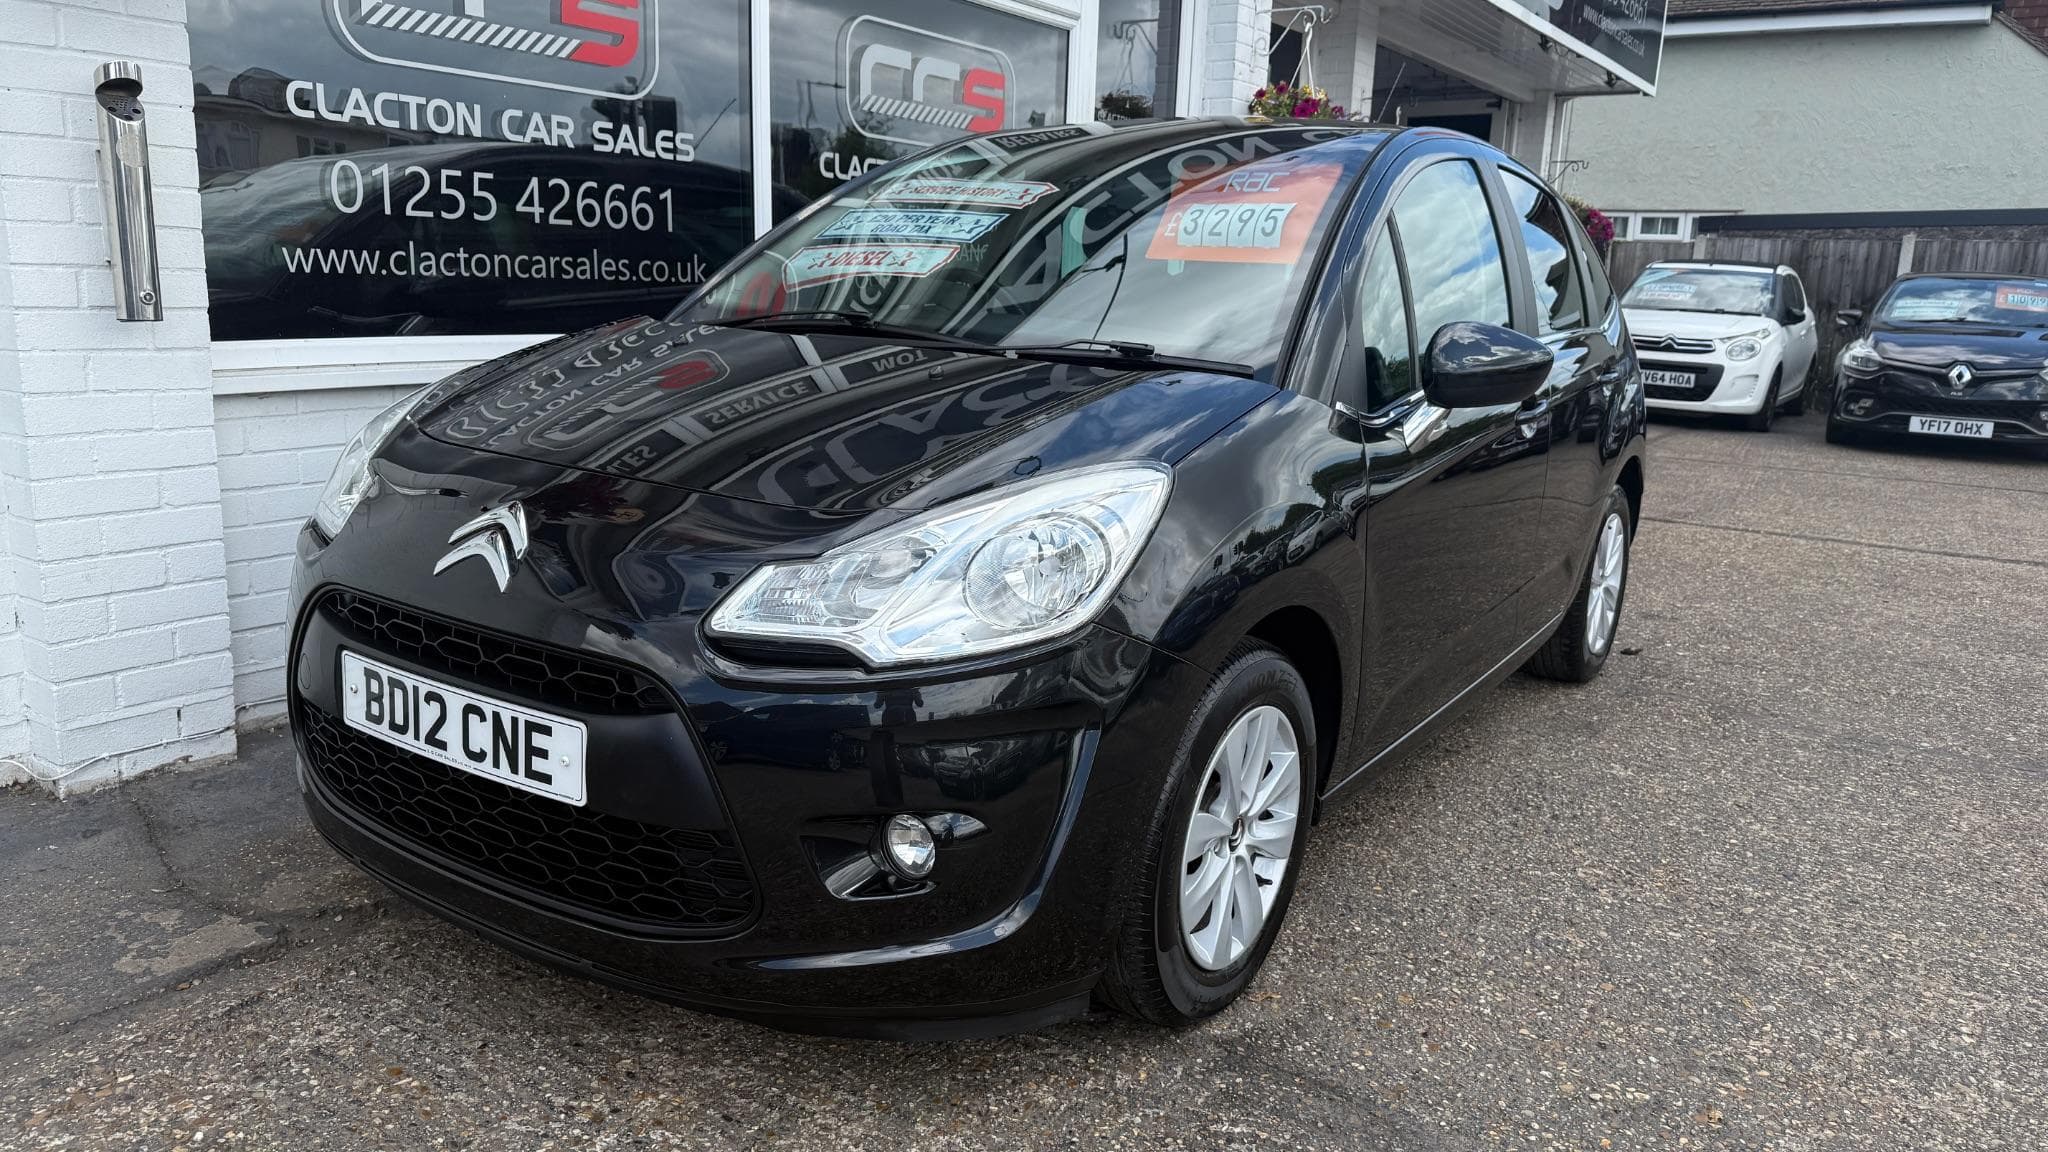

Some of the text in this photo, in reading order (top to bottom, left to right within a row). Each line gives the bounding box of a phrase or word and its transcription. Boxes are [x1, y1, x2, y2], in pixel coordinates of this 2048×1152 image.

[859, 43, 1006, 133] CCS
[286, 80, 696, 163] CLACTON CAR SALES
[819, 151, 890, 180] CLAC
[909, 185, 1009, 197] SERVICE HISTORY
[1222, 171, 1292, 194] RAC
[329, 159, 674, 233] 01255 426661
[870, 224, 935, 234] ROAD TAX
[925, 215, 960, 225] YEAR
[1164, 206, 1284, 238] £3295
[281, 240, 708, 285] www.clactoncarsales.co.uk
[831, 250, 892, 267] DIESEL
[1669, 374, 1692, 386] HOA
[1919, 418, 1984, 435] YF17 OHX
[363, 666, 553, 786] BD12 CNE
